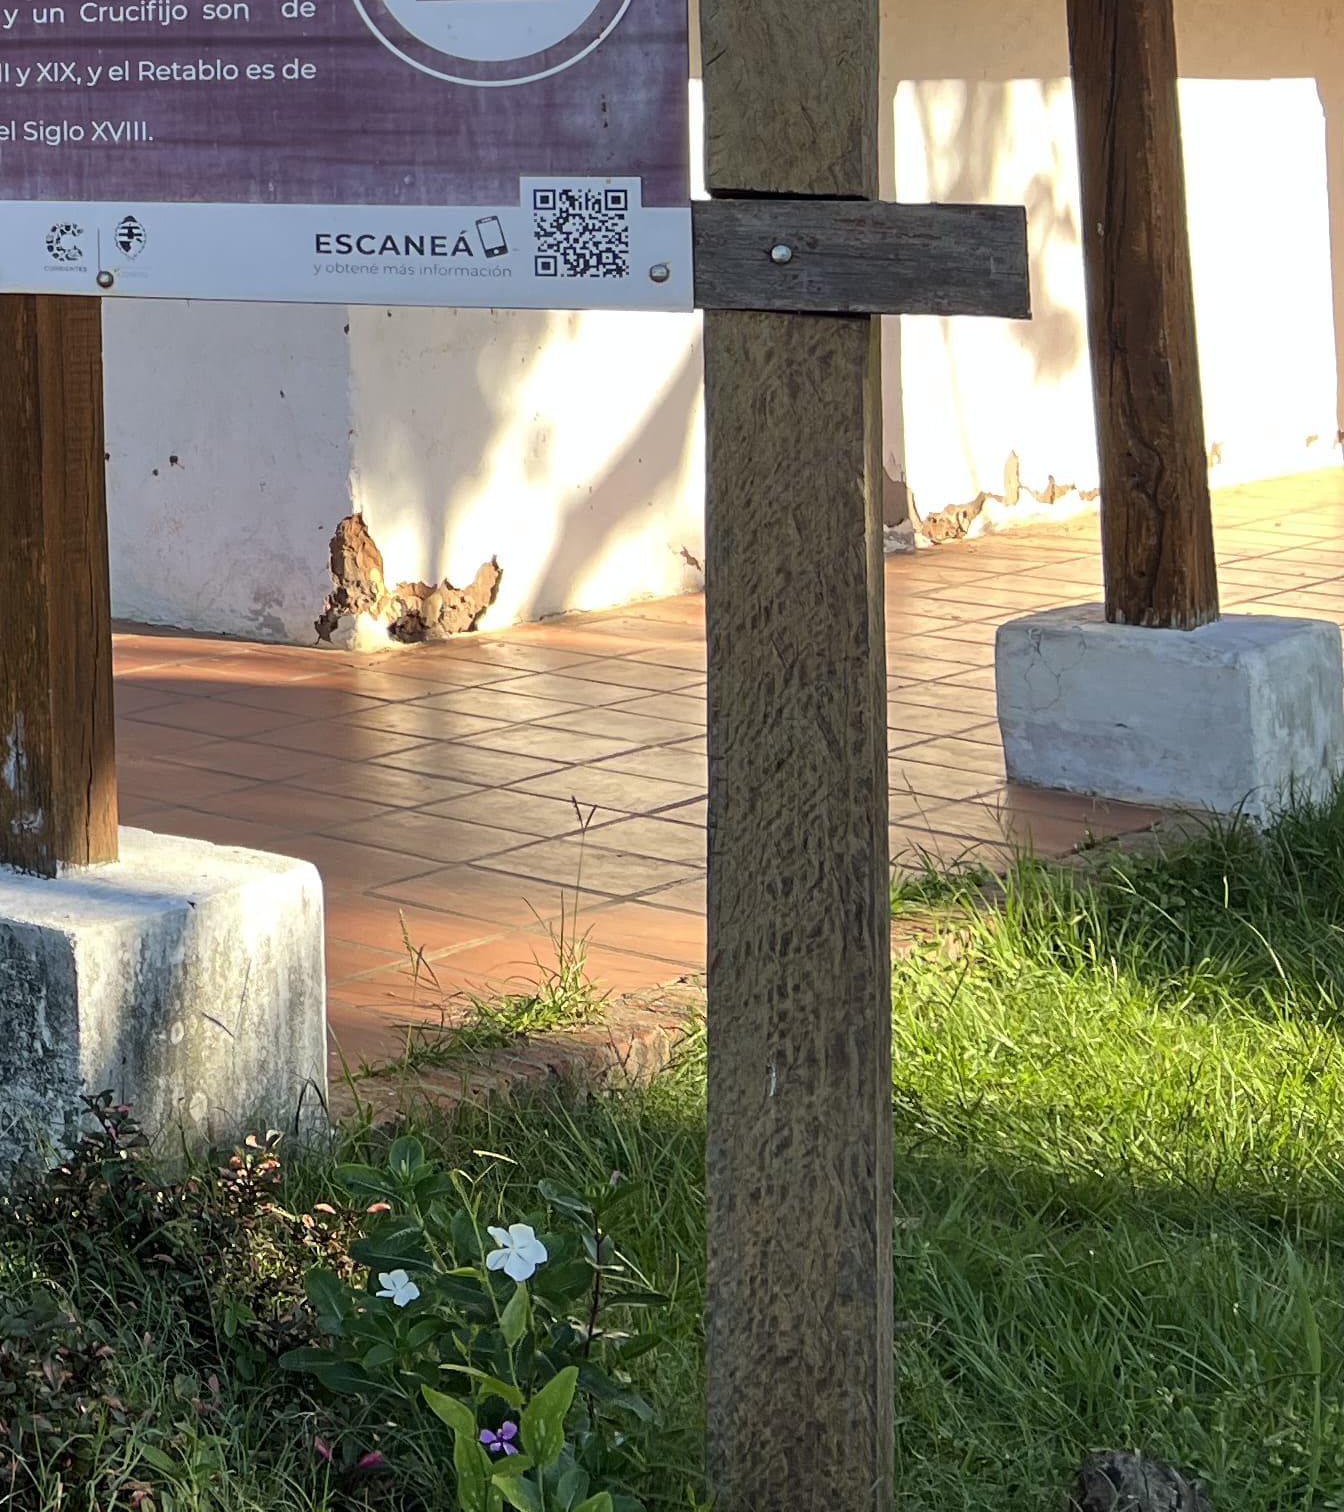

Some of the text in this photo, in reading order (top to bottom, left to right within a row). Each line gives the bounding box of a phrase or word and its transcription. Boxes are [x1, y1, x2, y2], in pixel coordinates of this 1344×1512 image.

[3, 8, 18, 30] y
[33, 7, 64, 24] un
[80, 0, 187, 26] Crucifijo
[203, 2, 249, 22] son
[16, 66, 30, 88] y
[37, 61, 81, 86] XIX,
[87, 65, 102, 87] y
[109, 59, 129, 82] el
[139, 58, 238, 82] Retablo
[246, 63, 275, 81] es
[282, 57, 316, 80] de
[24, 119, 84, 146] Siglo
[91, 120, 153, 144] XVIII.
[315, 230, 474, 258] ESCANEÁ
[313, 262, 512, 278] y obtené más información
